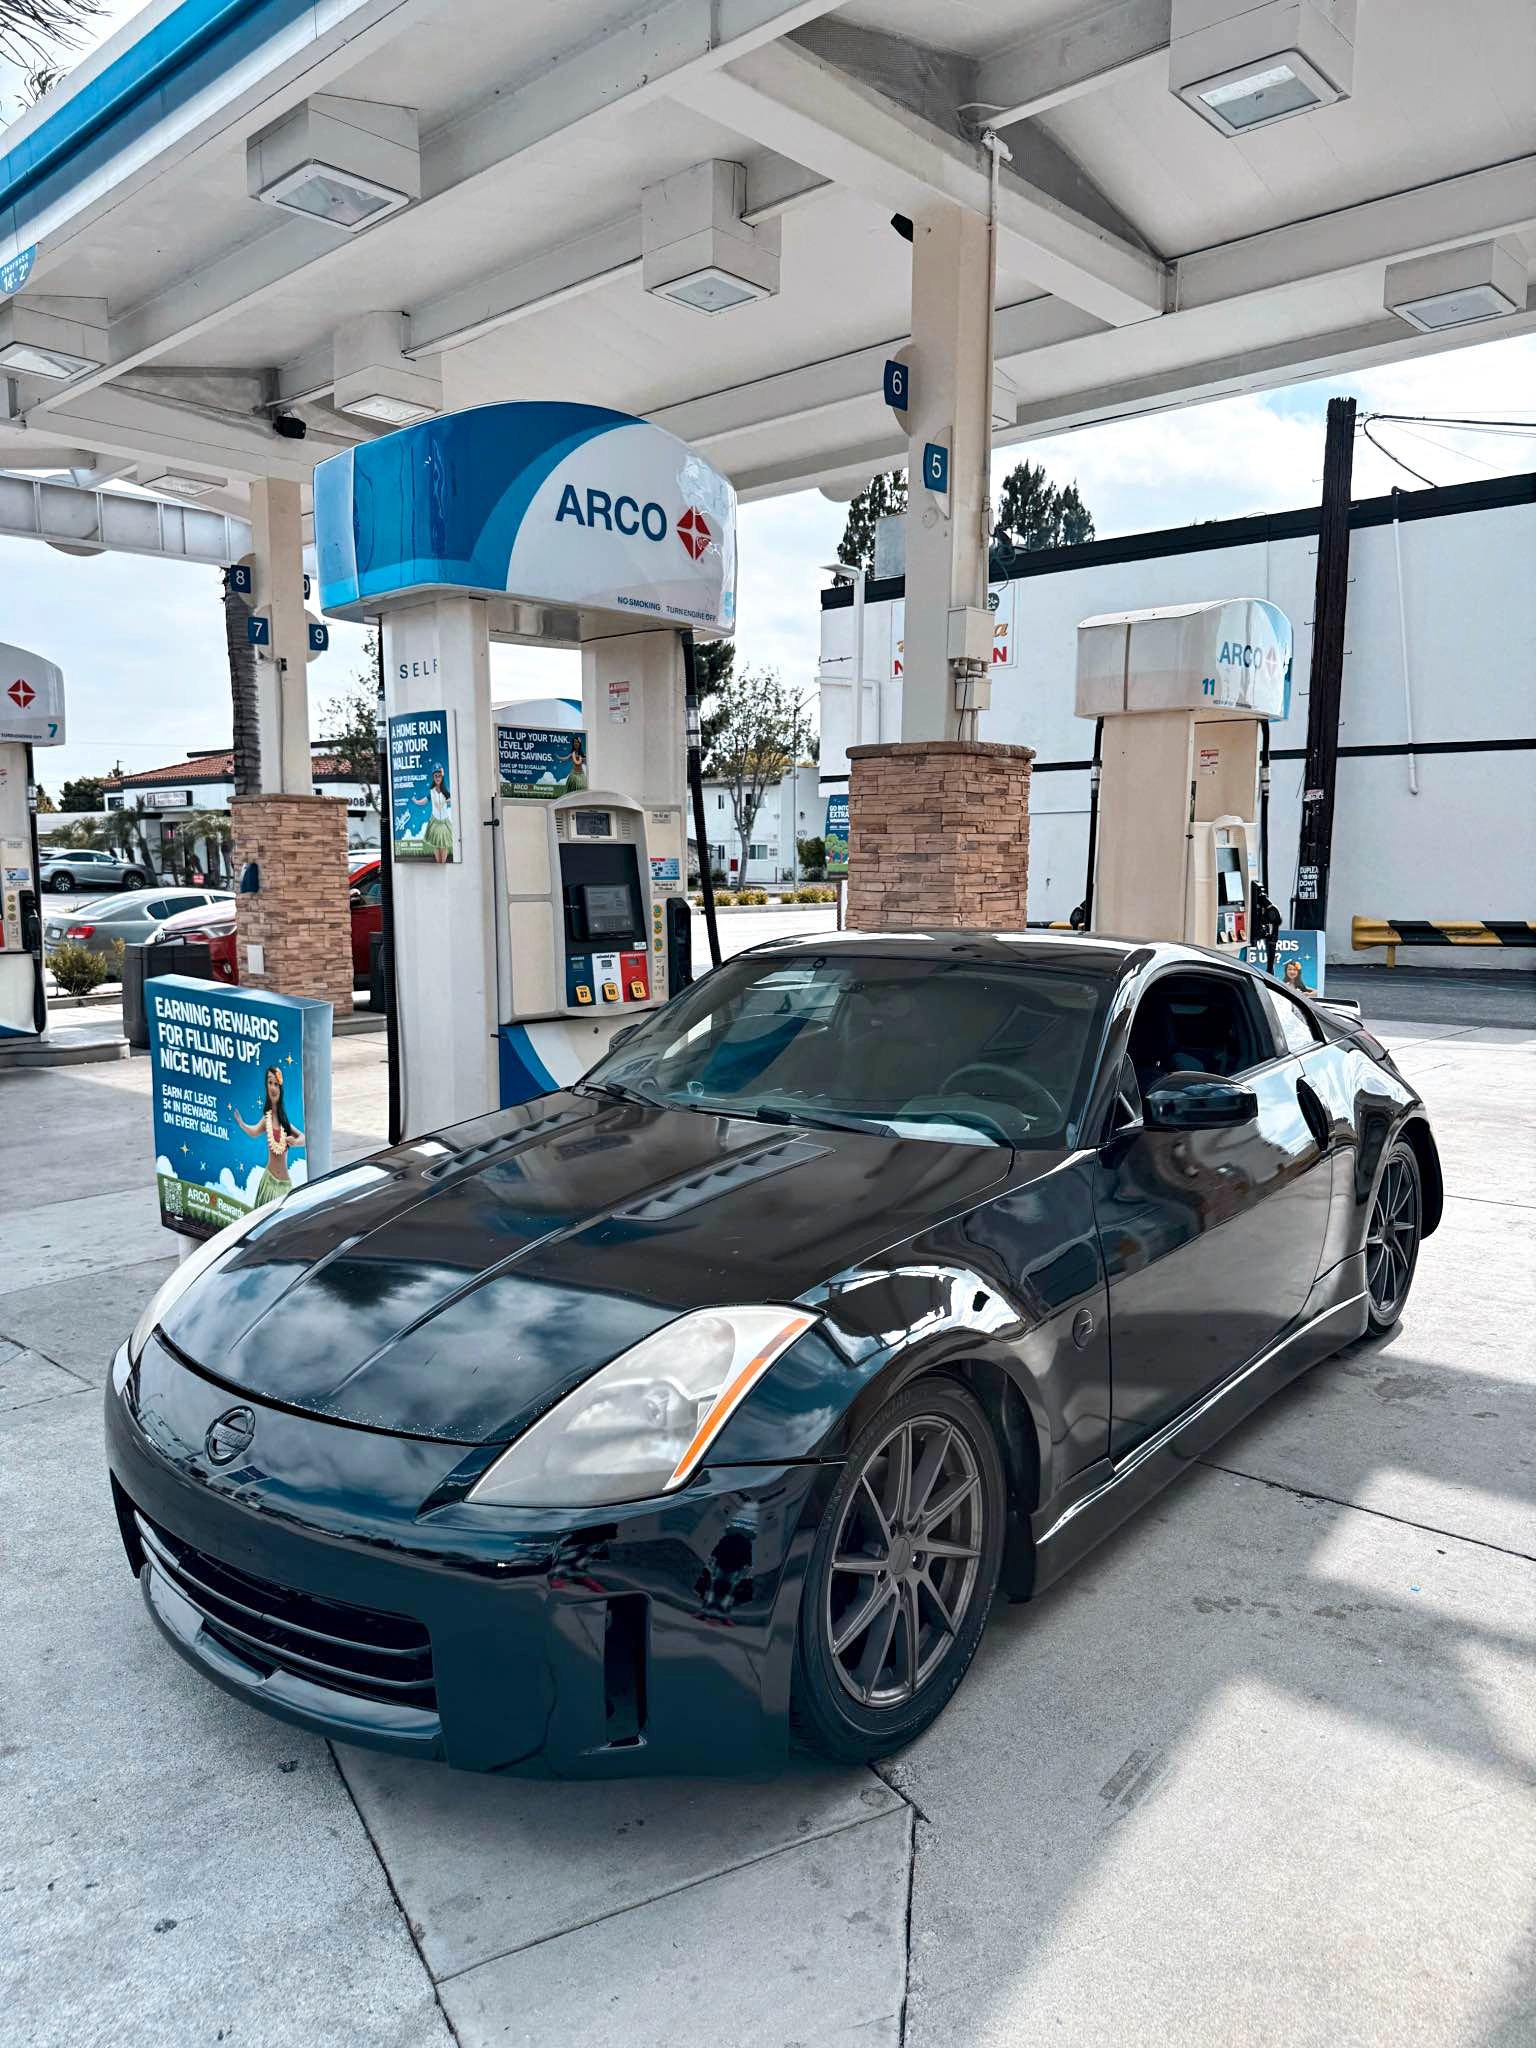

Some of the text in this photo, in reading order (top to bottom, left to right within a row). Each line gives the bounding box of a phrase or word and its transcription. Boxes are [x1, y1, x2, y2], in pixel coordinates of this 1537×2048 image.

[892, 370, 902, 395] 6
[931, 453, 942, 479] 5
[555, 484, 668, 542] ARCO
[235, 570, 245, 585] 8
[617, 596, 628, 605] NO
[629, 598, 661, 611] SMOKING
[666, 605, 683, 614] TURN
[253, 622, 263, 637] 7
[315, 629, 324, 644] 9
[1218, 641, 1263, 670] ARCO
[1202, 678, 1216, 696] 11
[47, 723, 58, 738] 7
[391, 719, 442, 739] A HOME RUN
[498, 730, 570, 744] FILL UP YOUR TANK.
[392, 737, 429, 754] FOR YOUR
[499, 740, 535, 751] LEVEL UP
[392, 755, 423, 770] WALLET.
[499, 750, 554, 762] YOUR SAVINGS.
[155, 996, 279, 1043] EARNING REWARDS
[158, 1022, 261, 1066] FOR FILLING UP?
[160, 1048, 232, 1085] NICE MOVE.
[162, 1083, 217, 1109] EARN AT LEAST
[173, 1100, 181, 1113] IN
[182, 1102, 218, 1123] REWARDS
[163, 1111, 230, 1141] ON EVERY GALLON.
[187, 1188, 210, 1204] ARCO
